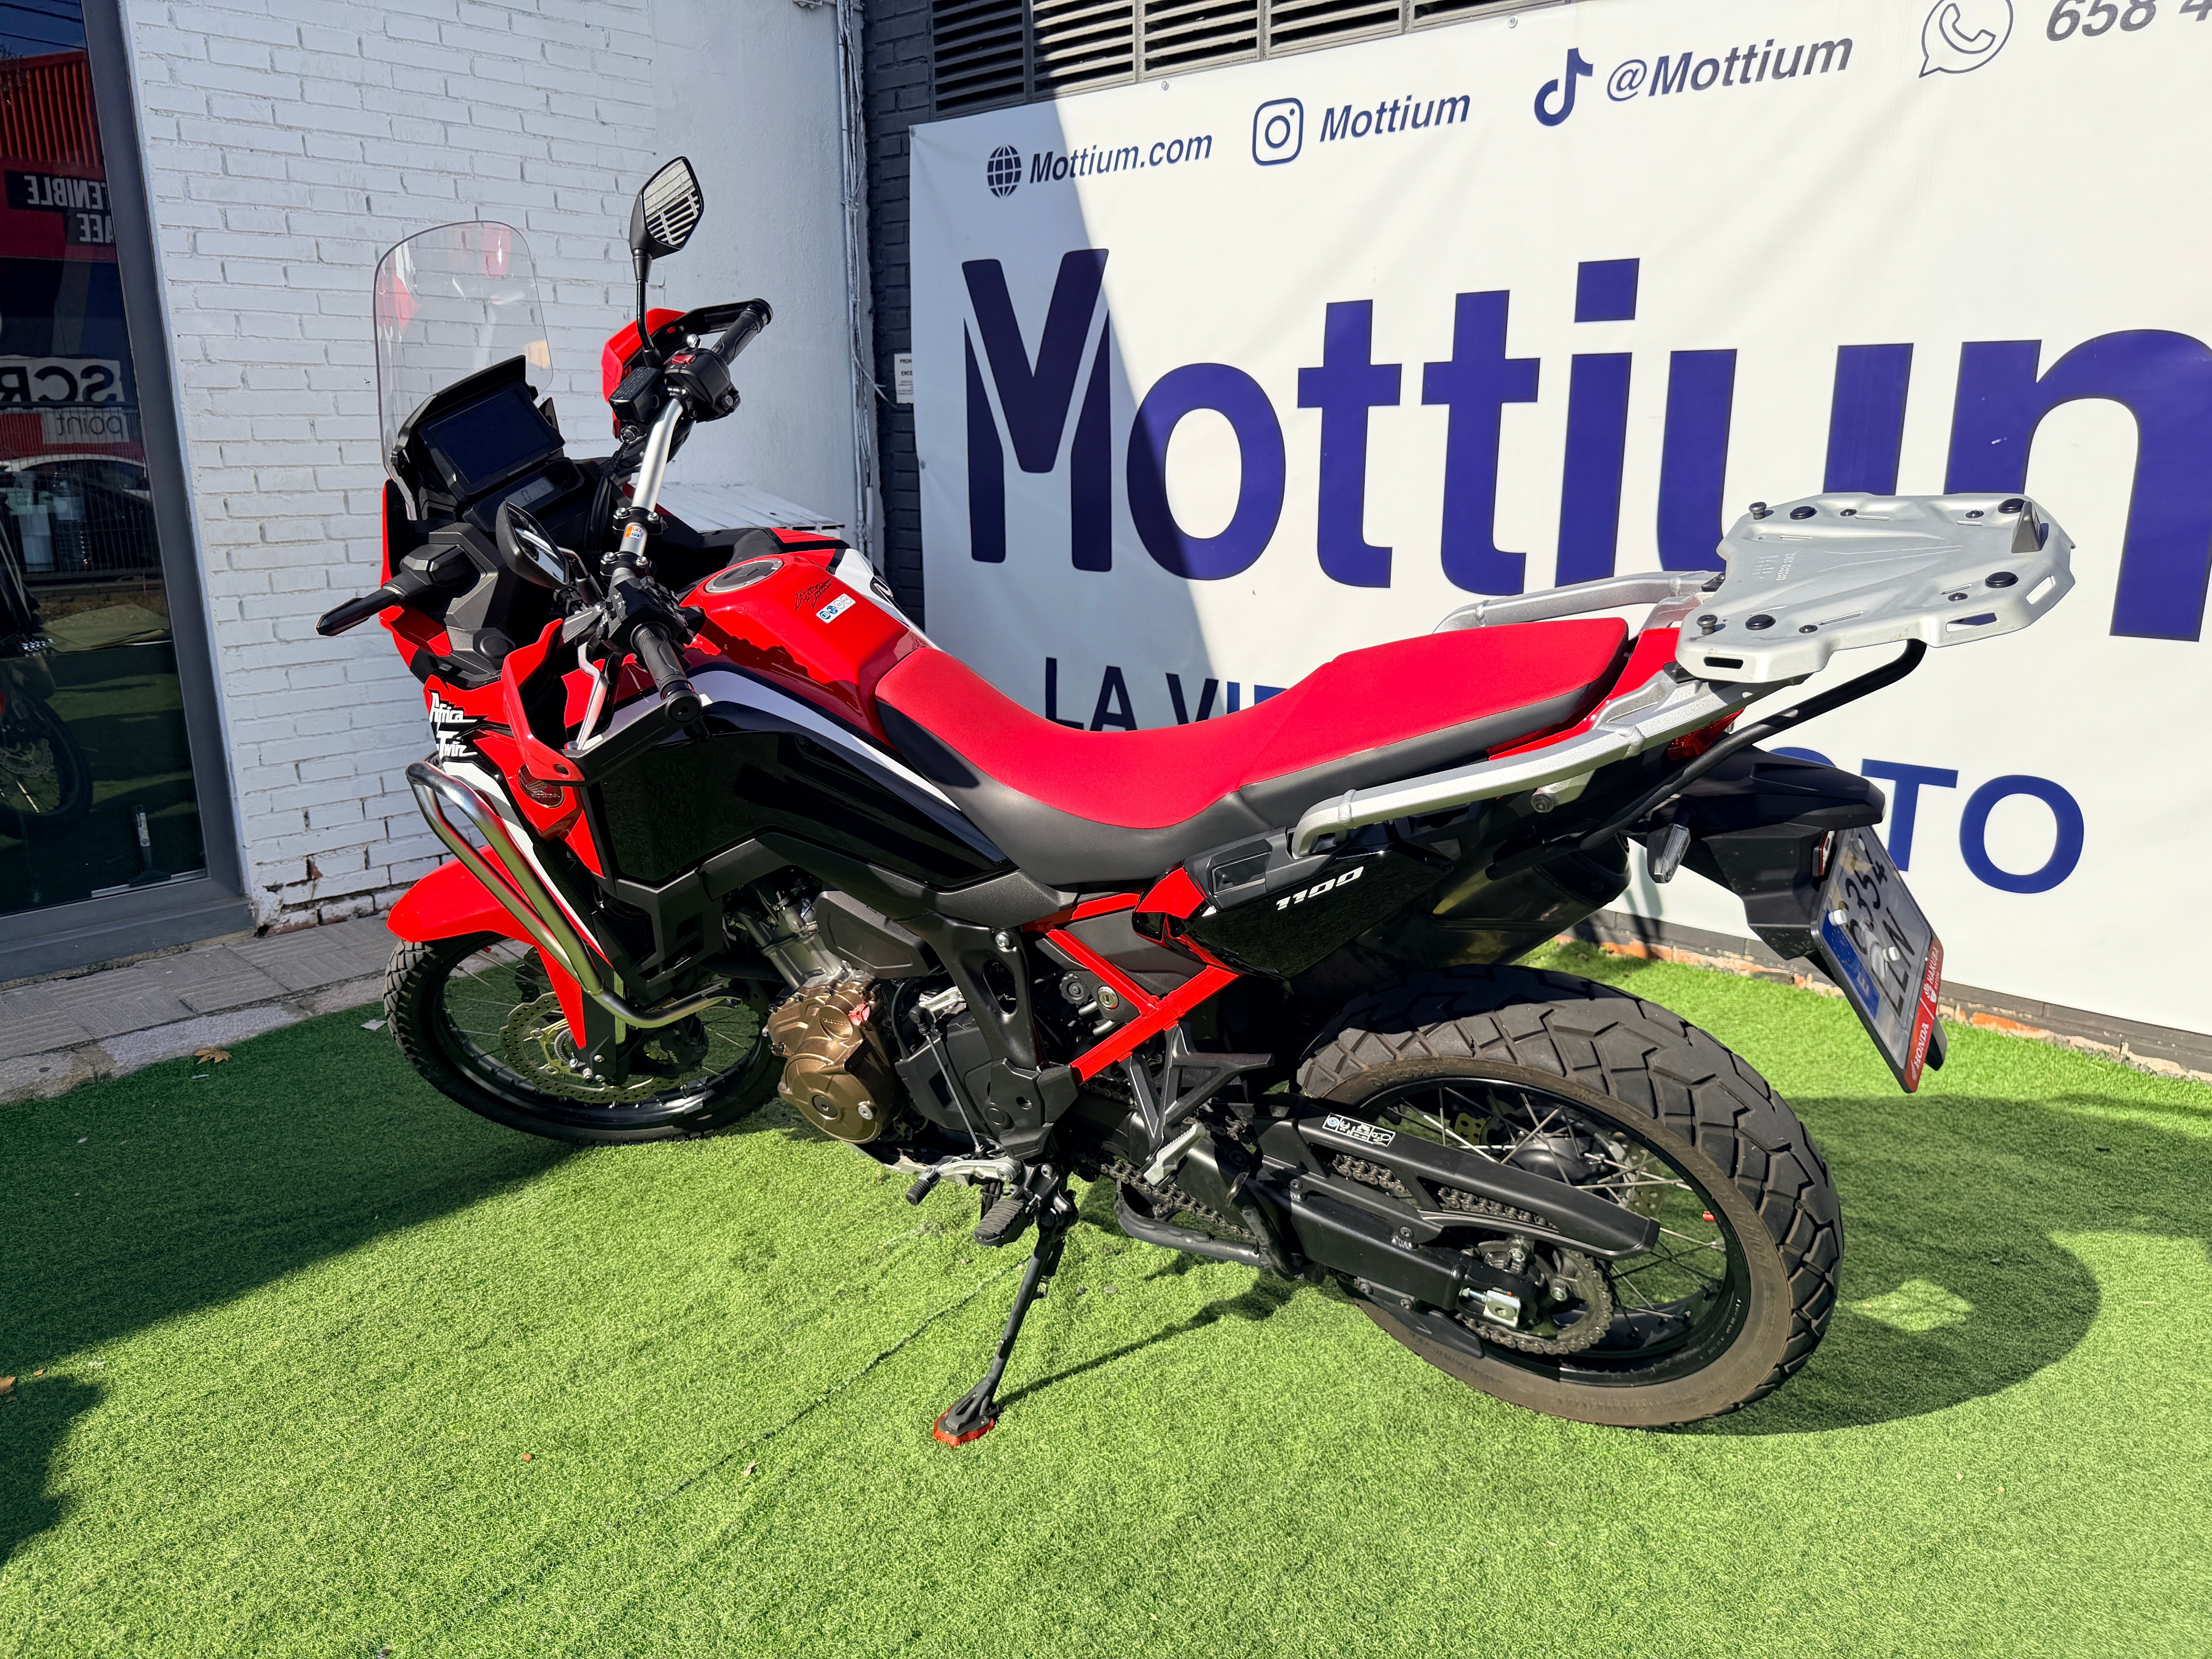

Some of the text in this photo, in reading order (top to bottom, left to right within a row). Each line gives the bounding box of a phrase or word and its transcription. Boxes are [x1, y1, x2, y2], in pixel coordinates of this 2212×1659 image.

[1607, 38, 1853, 101] @Mottium
[1320, 95, 1470, 142] Mottium
[1029, 135, 1212, 184] Mottium.com
[1045, 656, 1138, 732] LA
[1276, 866, 1364, 910] 1100
[1927, 946, 1939, 985] HAKUBA
[1913, 1022, 1929, 1070] HONDA
